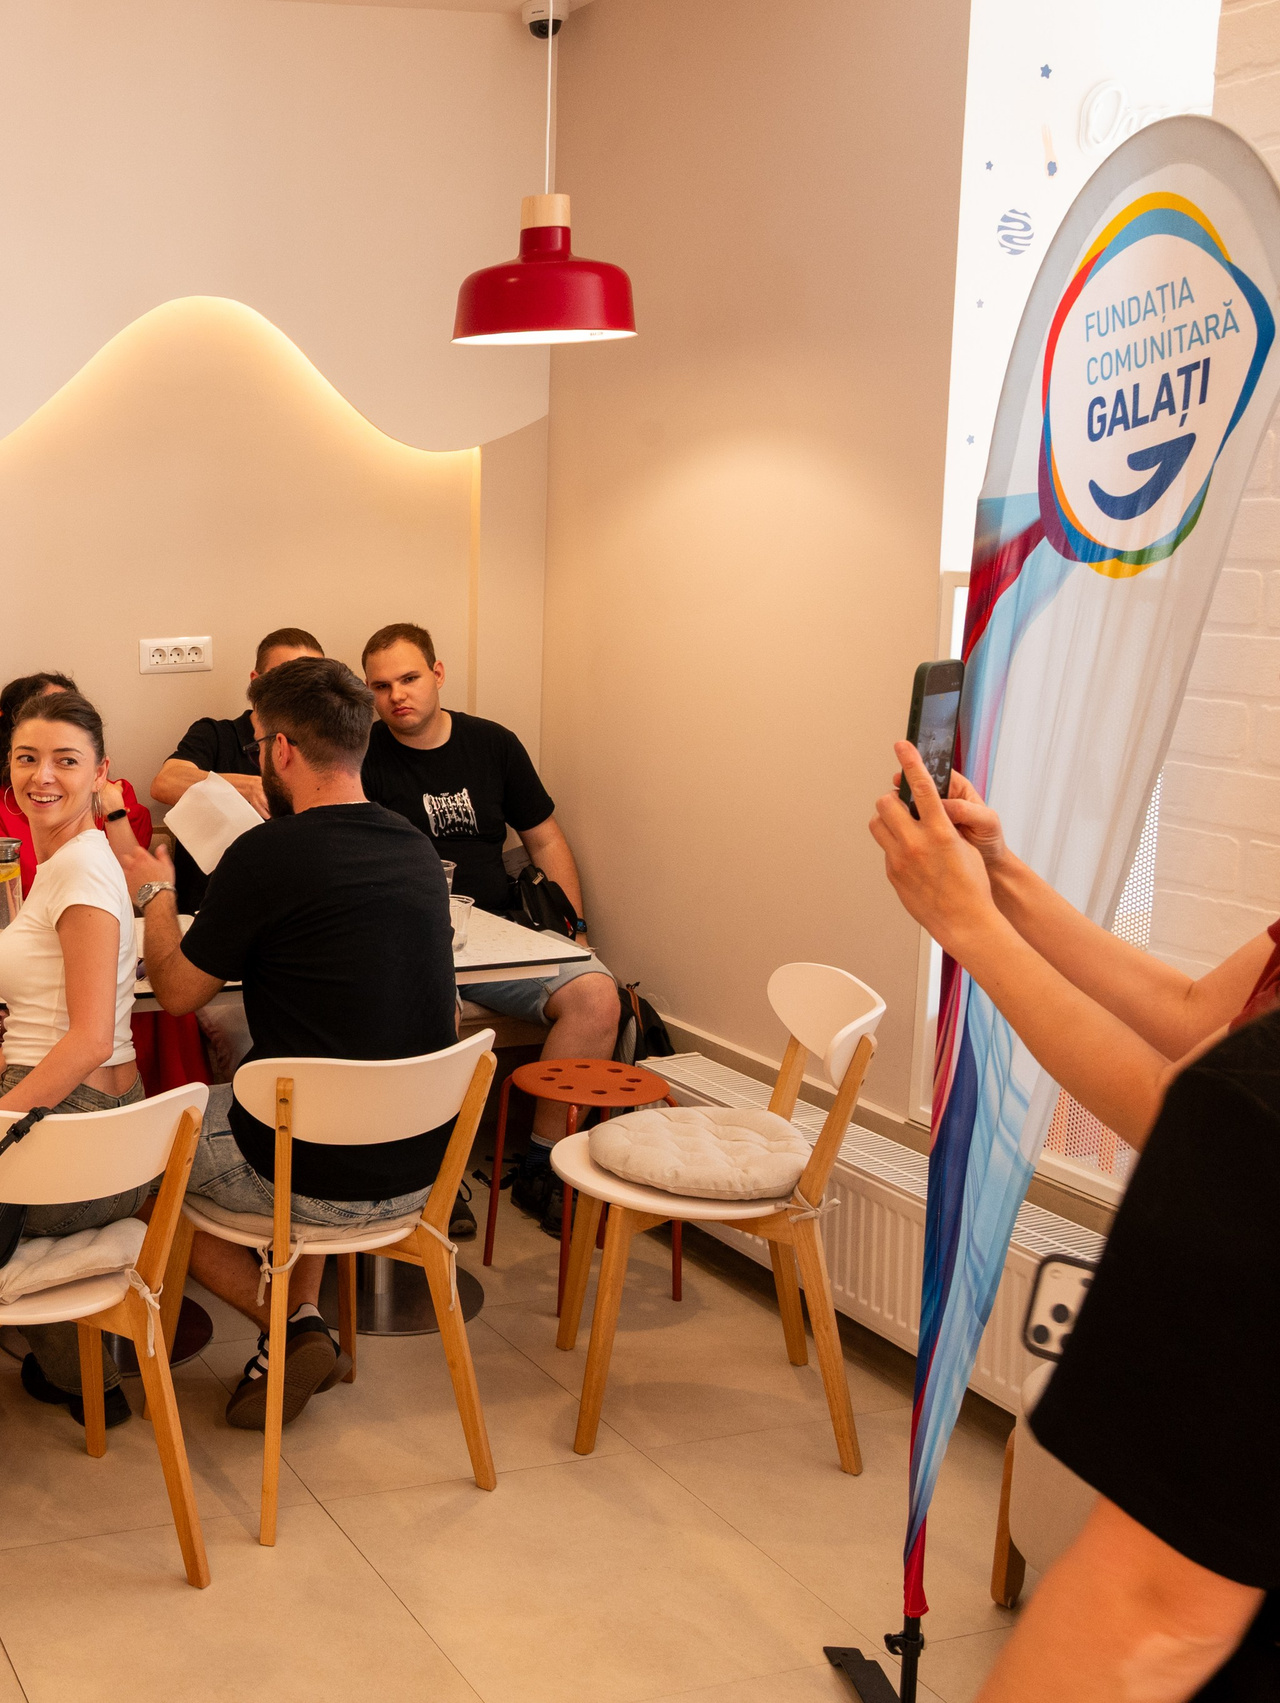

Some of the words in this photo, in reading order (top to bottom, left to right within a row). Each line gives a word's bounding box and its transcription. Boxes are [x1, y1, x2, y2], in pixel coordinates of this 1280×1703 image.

[1085, 276, 1195, 343] FUNDAȚIA
[1086, 299, 1240, 386] COMUNITARĂ
[1087, 357, 1211, 443] GALAȚI
